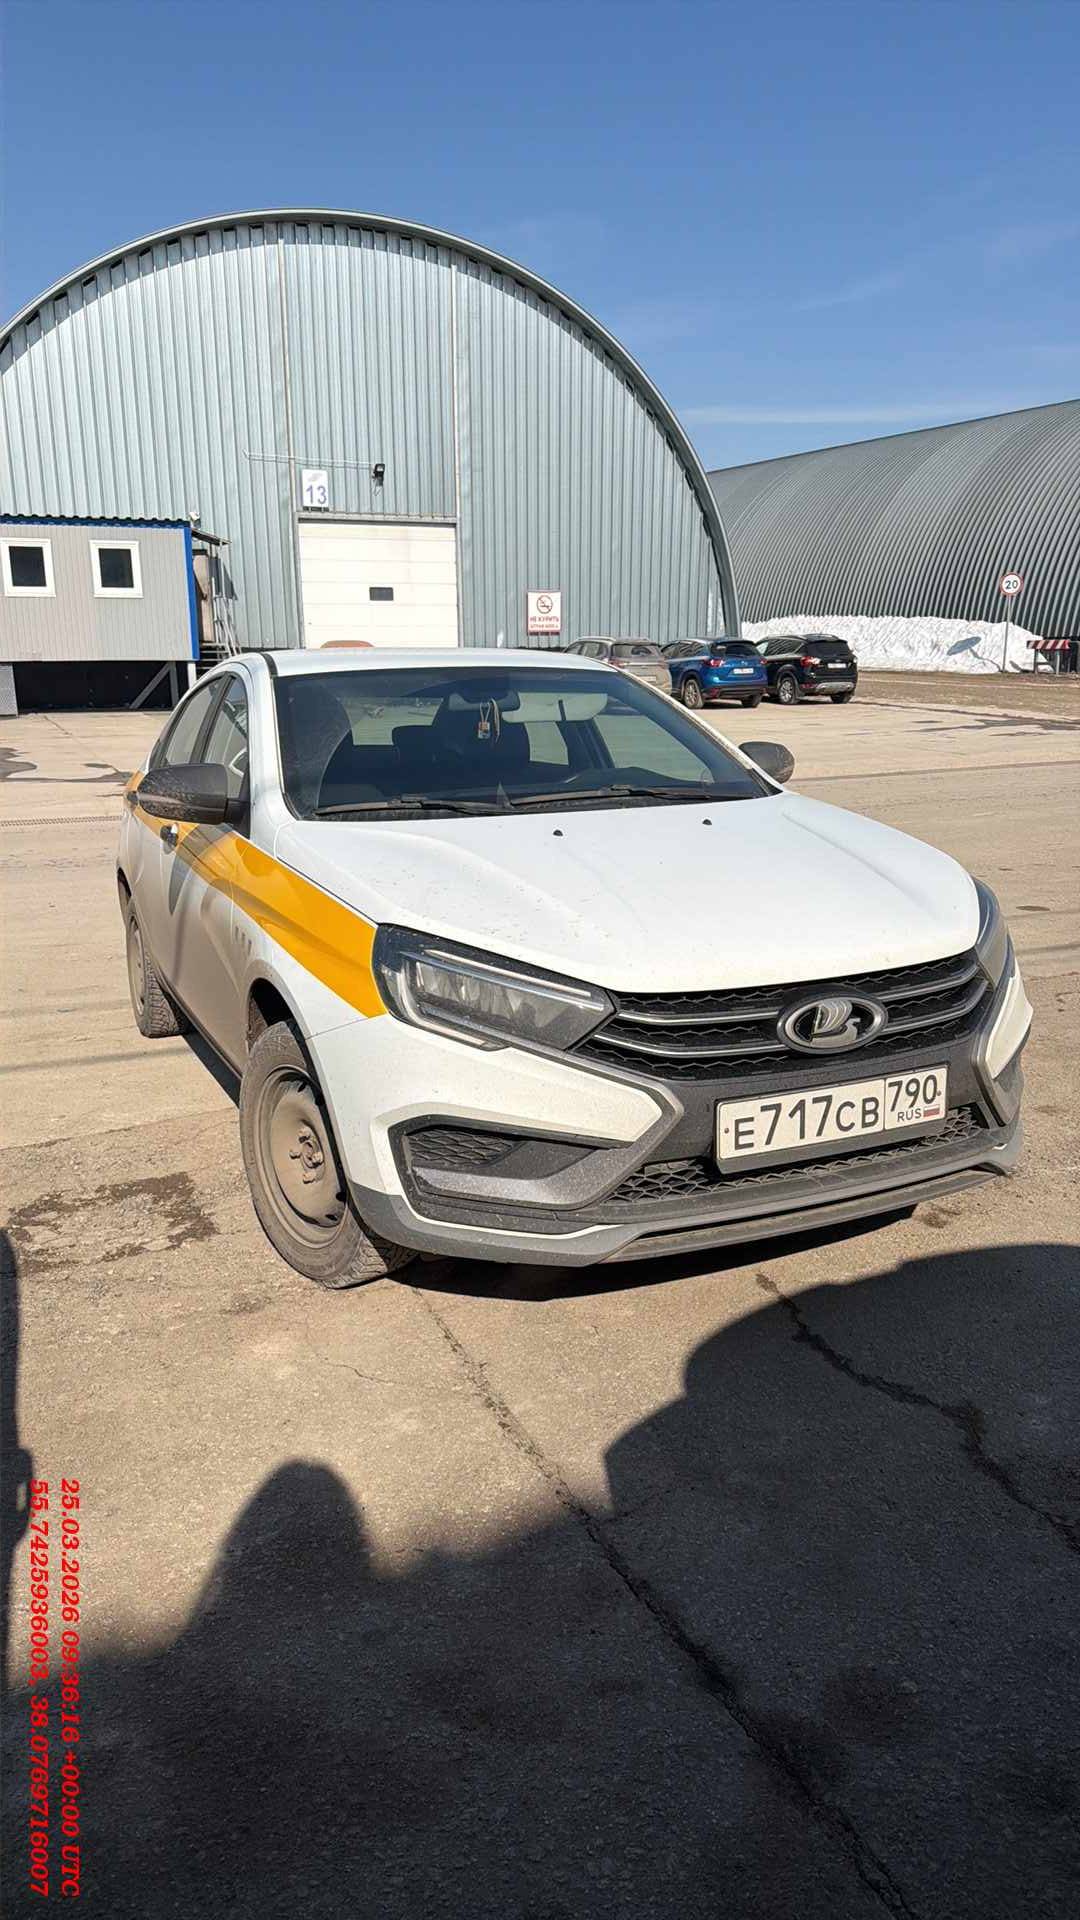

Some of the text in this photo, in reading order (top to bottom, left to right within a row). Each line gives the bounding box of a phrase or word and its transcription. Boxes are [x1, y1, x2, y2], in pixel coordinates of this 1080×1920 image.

[306, 485, 327, 505] 13
[1005, 580, 1018, 590] 20
[887, 1074, 938, 1112] 790
[896, 1107, 922, 1123] RUS
